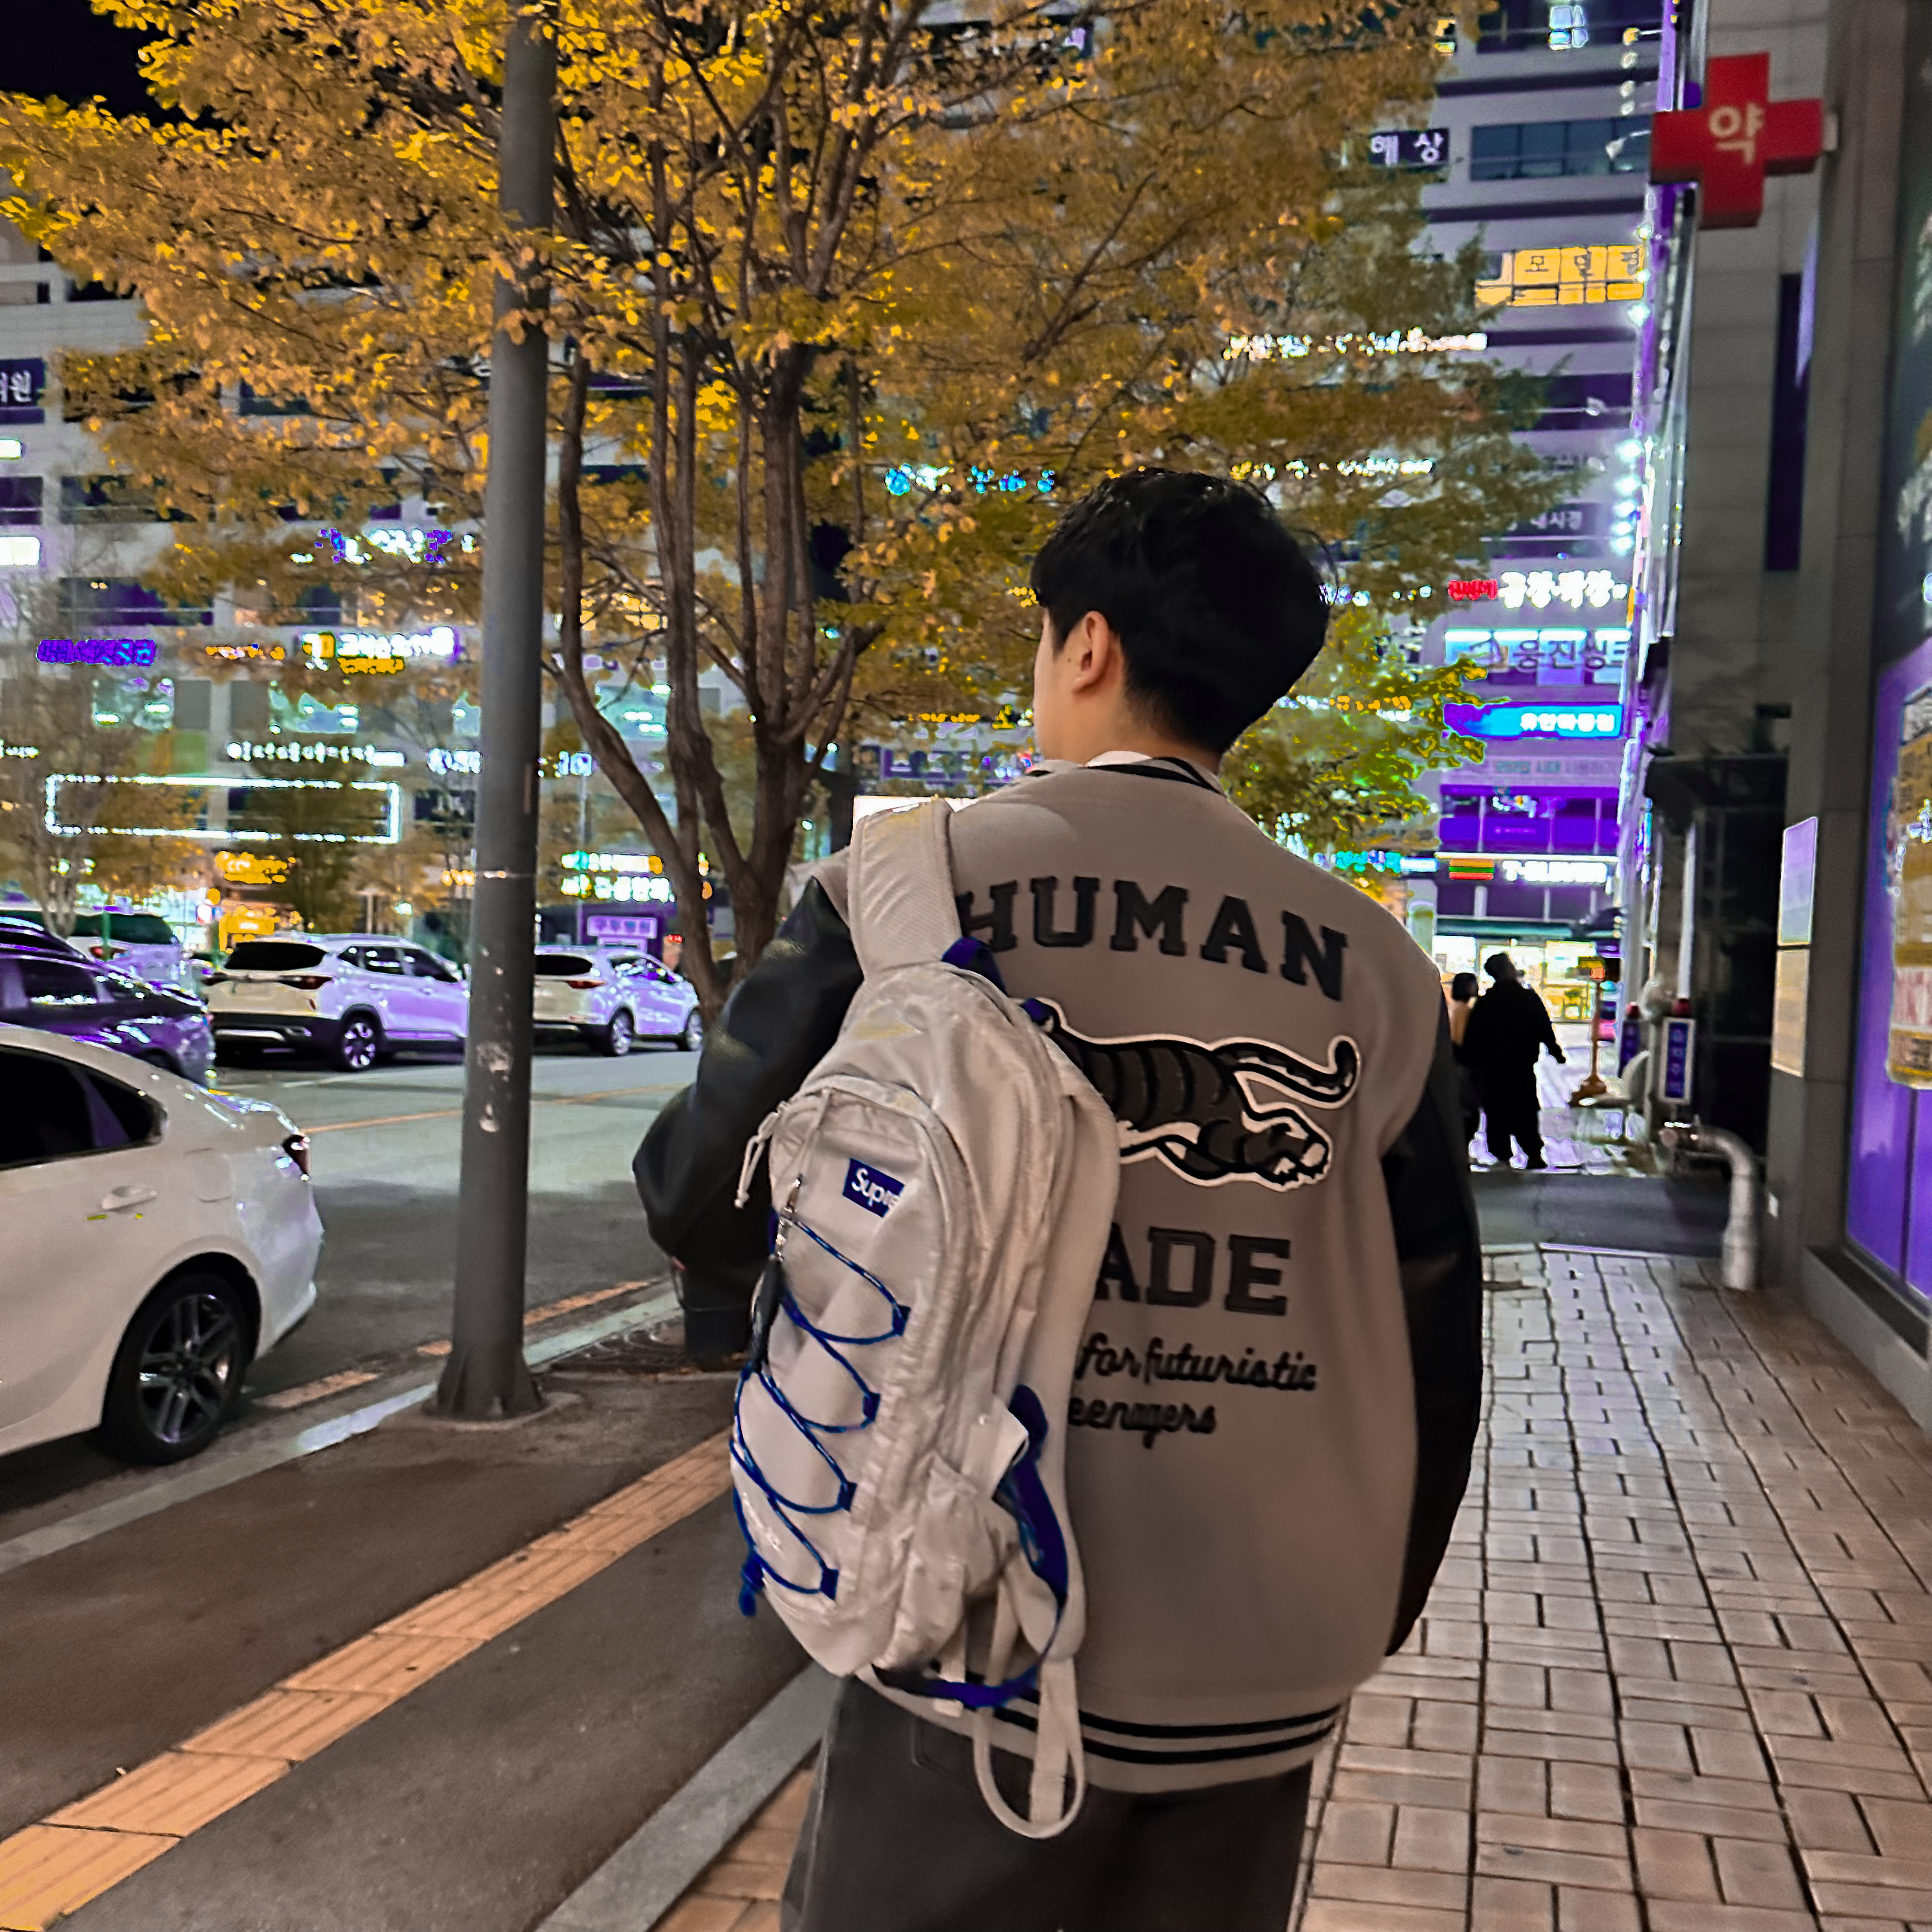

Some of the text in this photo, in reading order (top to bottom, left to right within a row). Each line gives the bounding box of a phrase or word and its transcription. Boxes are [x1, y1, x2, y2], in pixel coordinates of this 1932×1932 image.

[1708, 102, 1764, 165] 약
[956, 875, 1347, 1002] HUMAN
[1075, 1332, 1316, 1392] for futuristic
